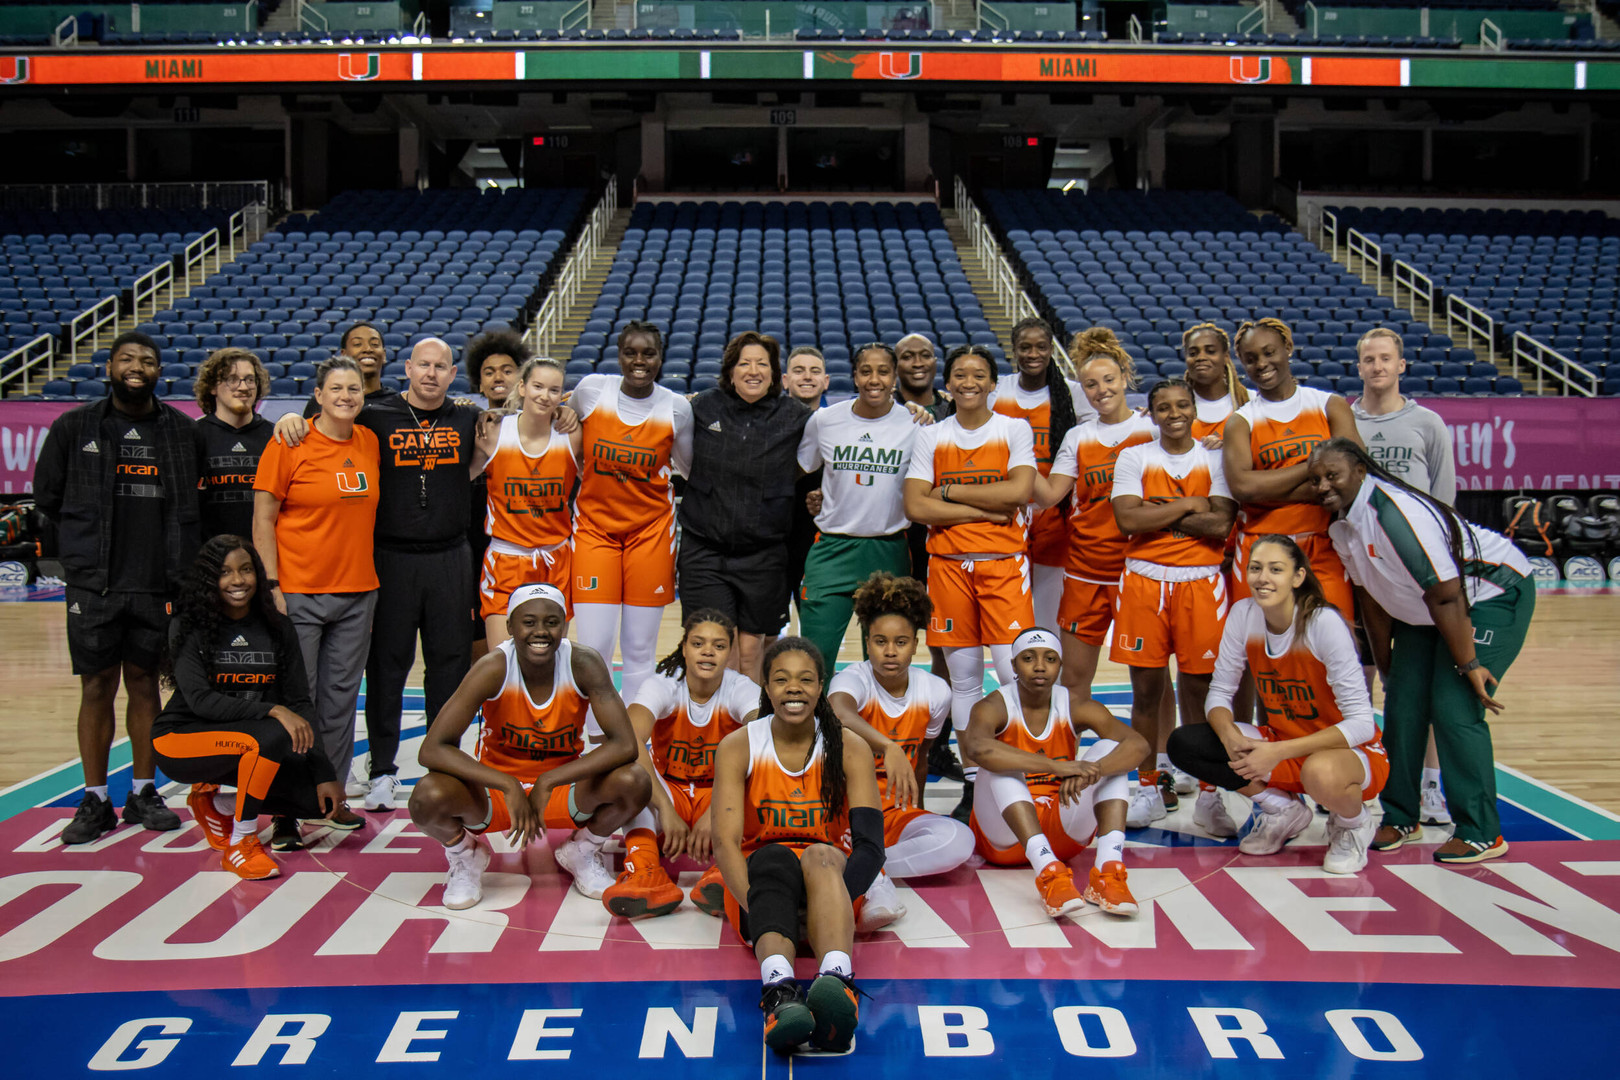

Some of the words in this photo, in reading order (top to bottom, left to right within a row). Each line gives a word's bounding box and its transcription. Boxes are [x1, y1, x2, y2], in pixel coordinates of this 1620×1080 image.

[145, 60, 202, 78] MIAMI
[1040, 58, 1096, 77] MIAMI
[772, 111, 794, 124] 109
[549, 135, 568, 148] 110
[389, 431, 461, 450] CANES
[1446, 416, 1516, 469] EN'S
[833, 445, 904, 466] MIAMI
[836, 463, 895, 474] HURRICANES
[87, 1005, 1425, 1071] GREENBORO
